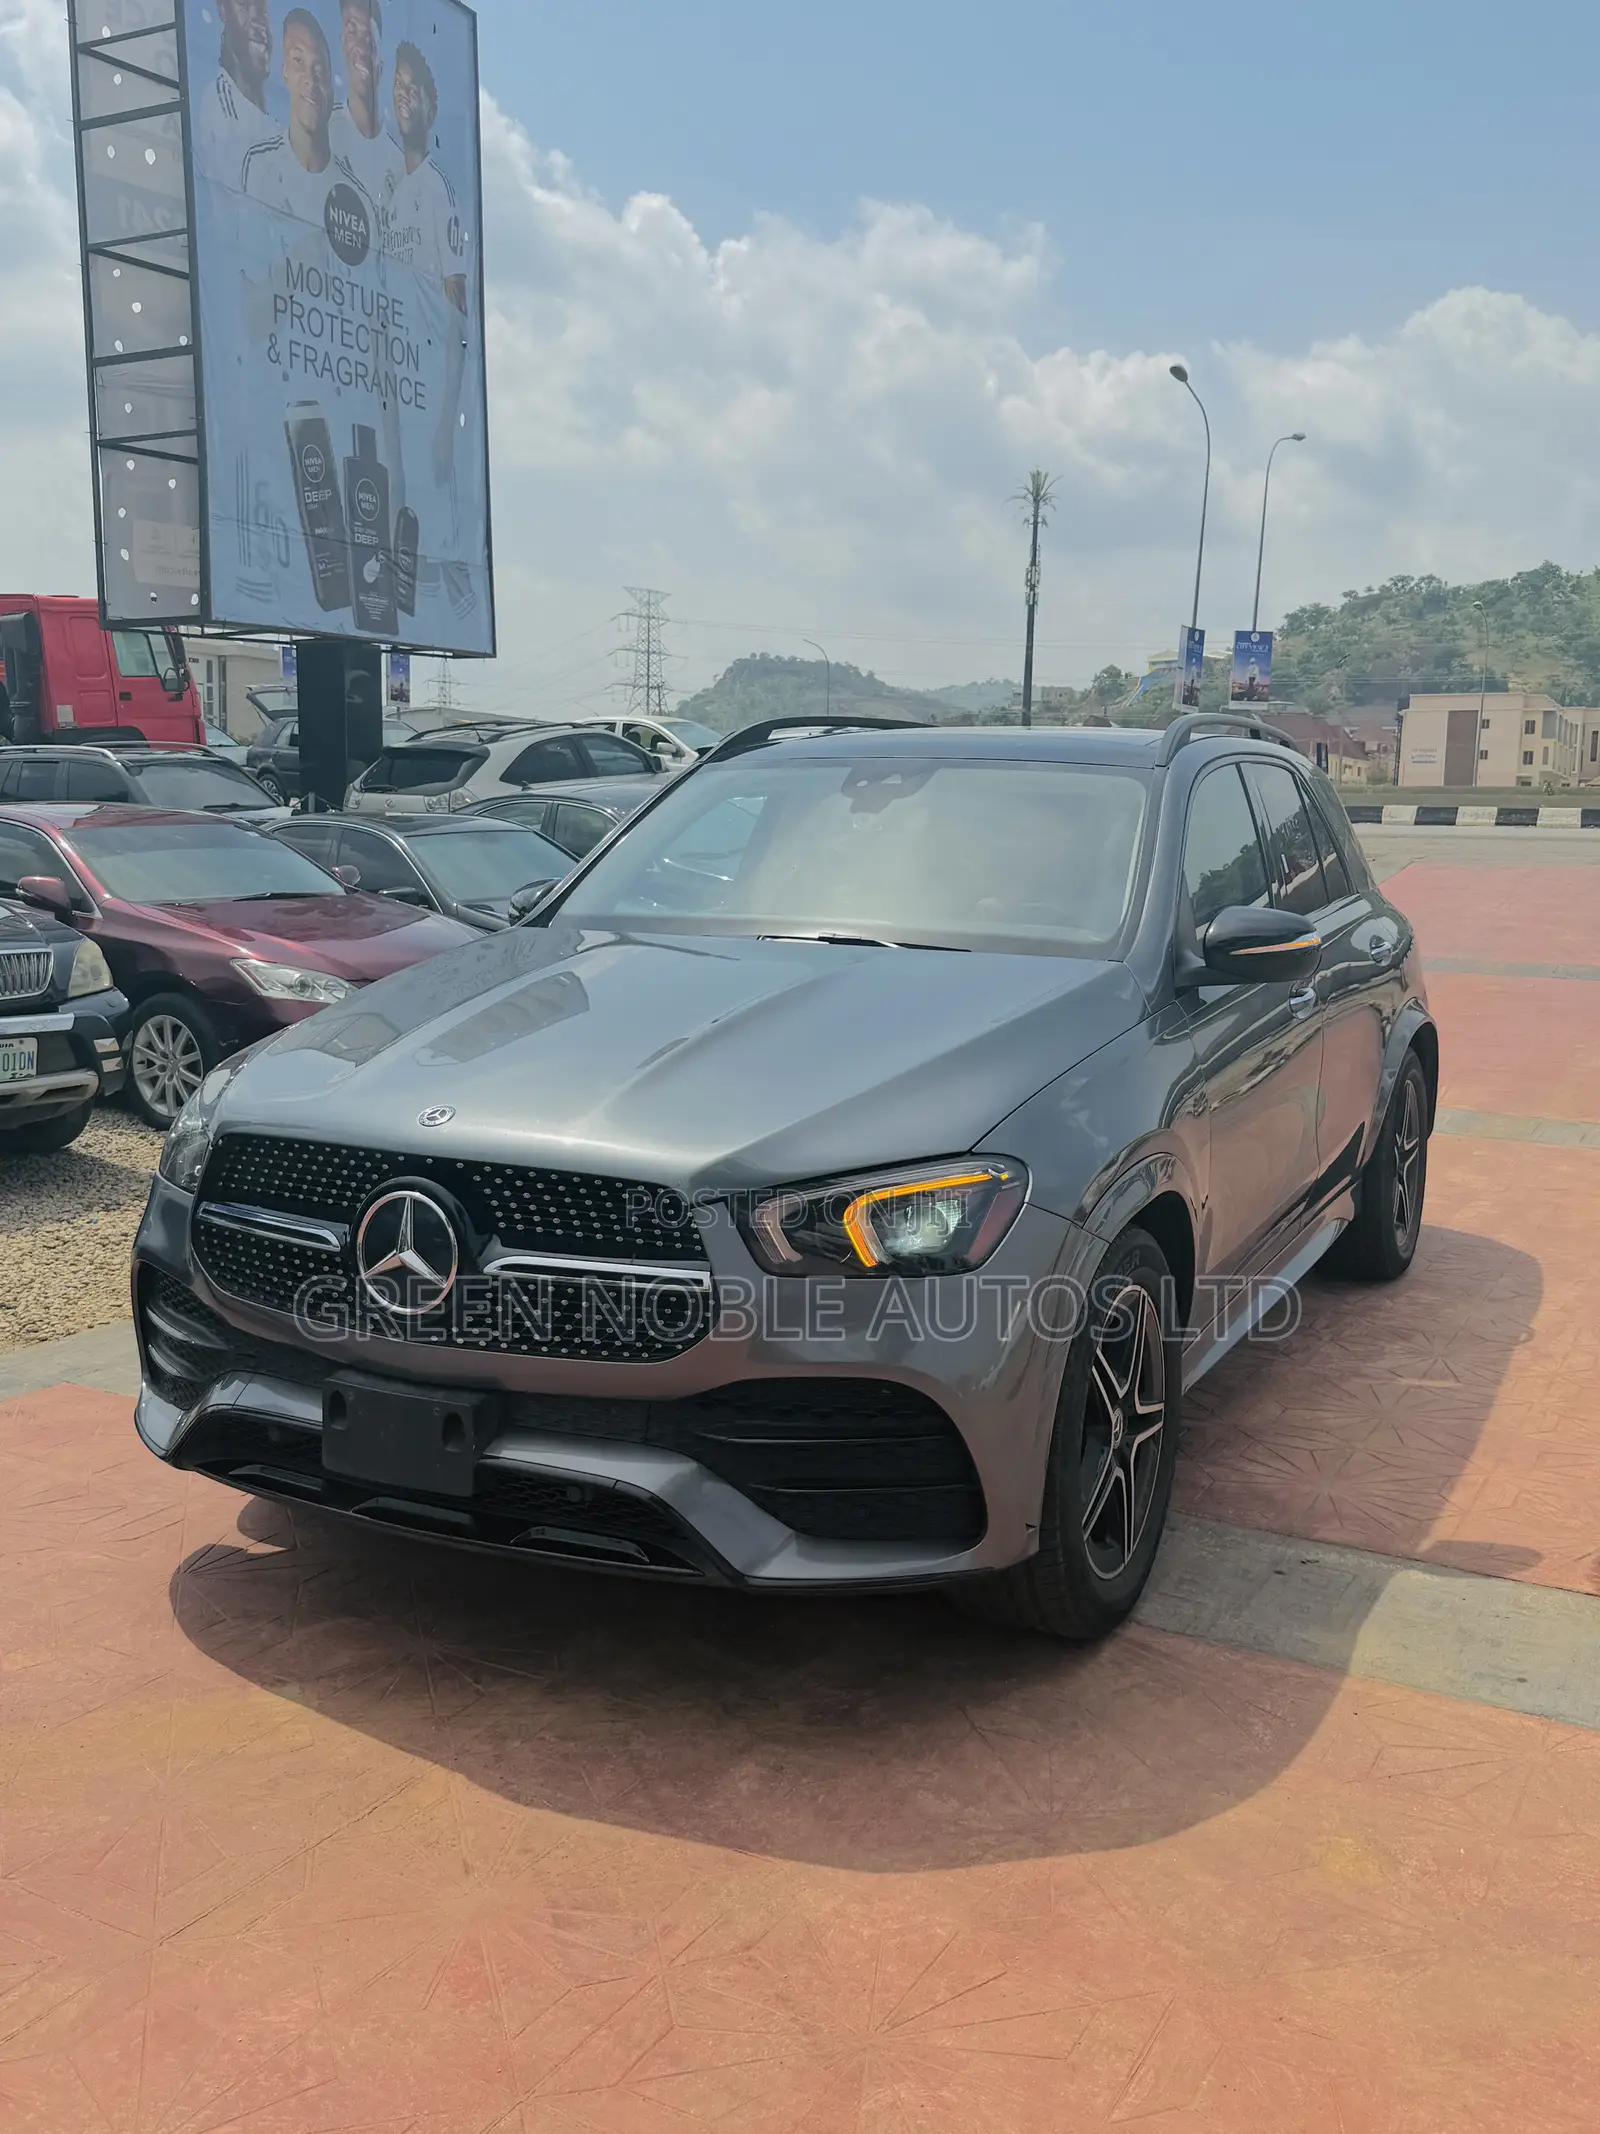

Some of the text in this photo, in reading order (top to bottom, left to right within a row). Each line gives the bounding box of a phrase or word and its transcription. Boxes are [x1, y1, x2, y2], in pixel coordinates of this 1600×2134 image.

[329, 205, 367, 235] NIVEA
[334, 226, 362, 249] MEN
[286, 257, 409, 336] MOISTURE,
[273, 293, 419, 373] PROTECTION
[267, 333, 427, 411] & FRAGRANCE
[304, 457, 322, 466] NIVEA
[304, 489, 332, 503] DEEP
[358, 492, 377, 503] NIVEA
[360, 502, 375, 511] MEN
[354, 533, 379, 546] DEEP
